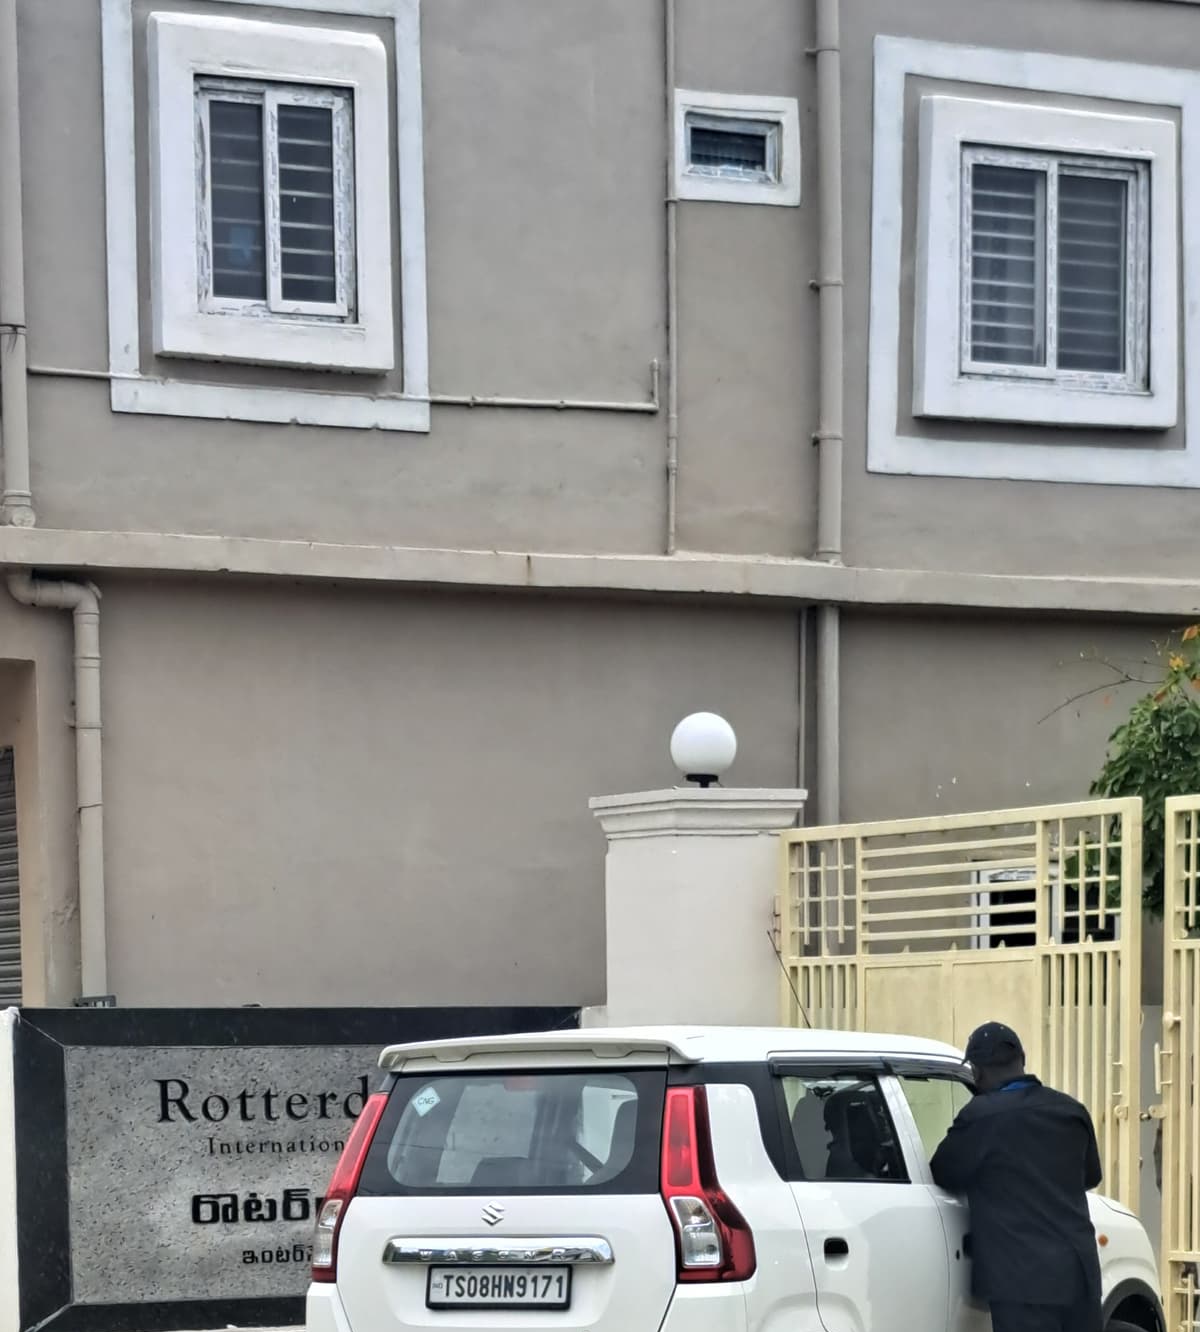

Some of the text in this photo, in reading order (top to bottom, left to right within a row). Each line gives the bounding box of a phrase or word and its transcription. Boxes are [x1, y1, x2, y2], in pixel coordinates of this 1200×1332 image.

[416, 1095, 436, 1105] CNG
[191, 1188, 326, 1225] రొటర్
[443, 1274, 564, 1299] TS08HN9171
